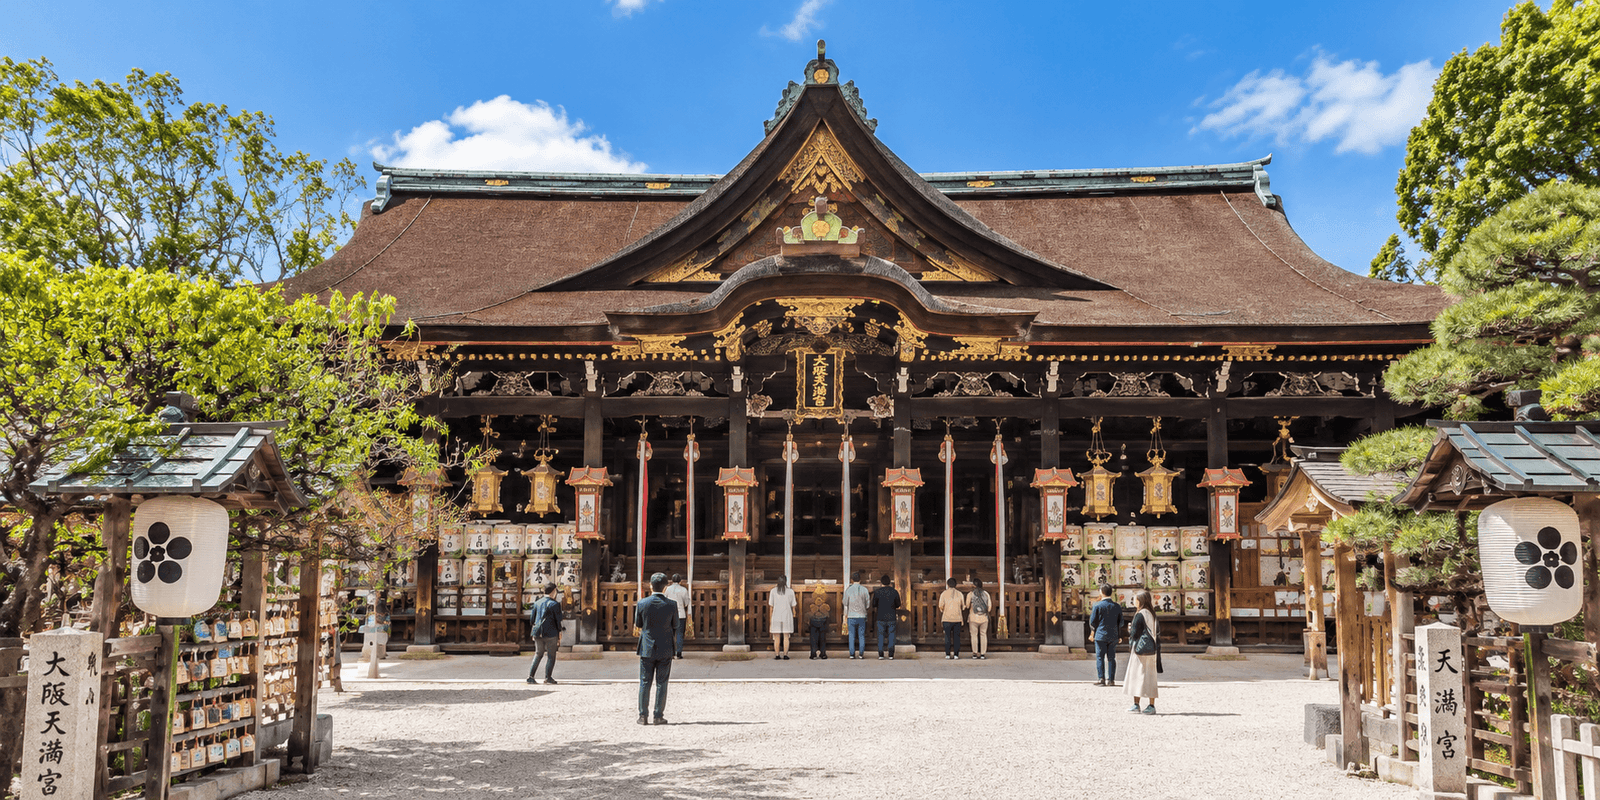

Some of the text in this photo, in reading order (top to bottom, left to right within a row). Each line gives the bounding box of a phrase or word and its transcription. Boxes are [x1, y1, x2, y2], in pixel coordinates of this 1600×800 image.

[36, 651, 70, 796] 大阪天満宮
[1434, 648, 1458, 760] 天満宮
